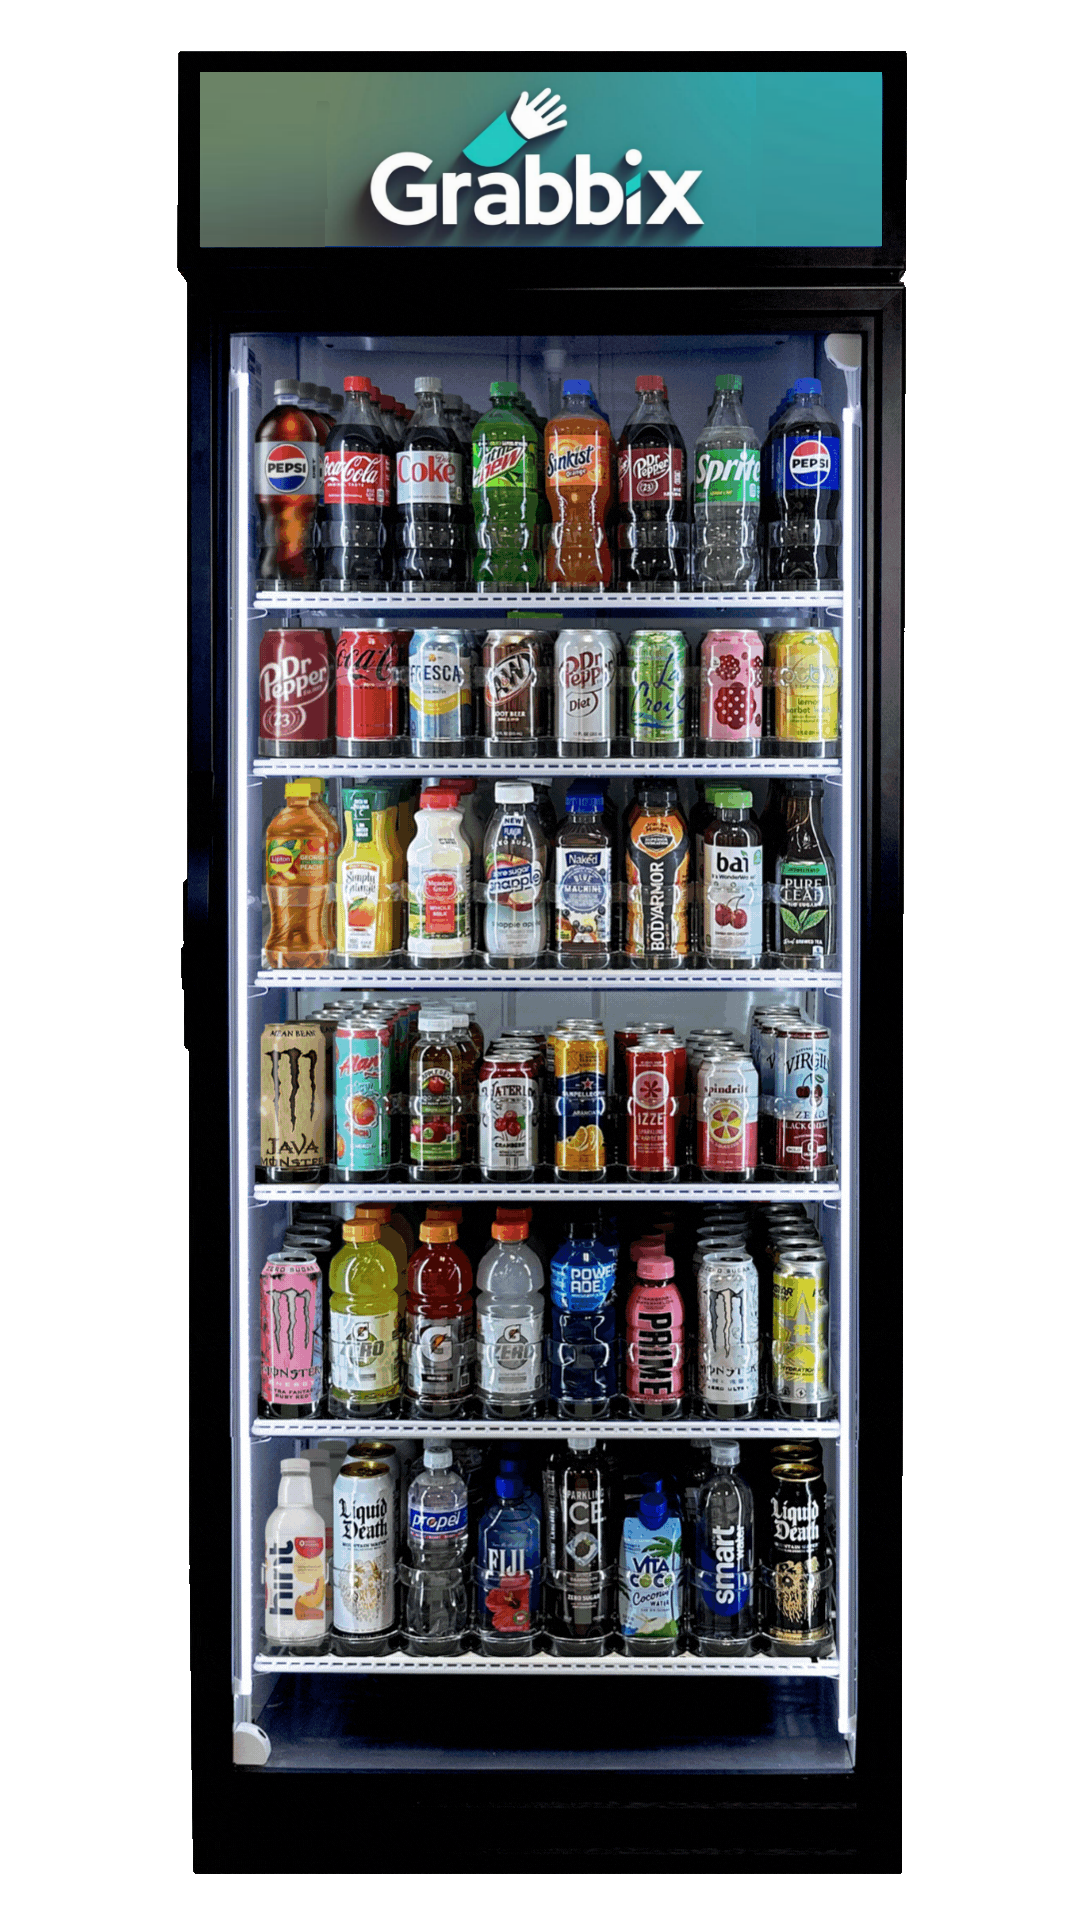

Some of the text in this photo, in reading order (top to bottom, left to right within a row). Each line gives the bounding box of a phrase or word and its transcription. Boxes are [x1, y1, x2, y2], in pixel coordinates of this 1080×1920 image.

[370, 148, 704, 227] Grabbix
[646, 454, 661, 464] Dr
[791, 458, 829, 469] PEPSI
[266, 462, 306, 473] PEPSI
[397, 455, 456, 484] Coke
[633, 457, 669, 480] Pepper
[696, 450, 760, 489] Sprite
[641, 483, 652, 491] 23
[281, 655, 313, 680] Dr
[579, 651, 602, 672] Dr
[261, 662, 328, 703] Pepper
[494, 654, 526, 701] A&W
[569, 697, 591, 713] Diet
[273, 712, 290, 728] 23
[510, 710, 526, 718] BEER
[504, 817, 522, 825] NEW
[717, 850, 749, 873] bai
[346, 870, 376, 885] Simply
[508, 865, 531, 877] sugar
[572, 873, 596, 883] BLUE
[563, 884, 602, 894] MACHINE
[784, 878, 823, 890] PURE
[784, 889, 820, 902] LEAF
[649, 861, 665, 952] BODYARMOR
[295, 1029, 317, 1038] BEAN
[339, 1052, 384, 1078] Alan
[704, 1083, 749, 1097] spindrift
[637, 1112, 664, 1126] IZZE
[795, 1110, 826, 1119] ZERO
[265, 1132, 319, 1155] JAVA
[261, 1156, 325, 1167] MONSTER
[289, 1265, 315, 1273] SUGAR
[571, 1280, 601, 1293] ADE
[494, 1344, 535, 1360] ZERO
[638, 1312, 673, 1395] PRIME
[262, 1365, 322, 1380] MONSTER
[701, 1364, 756, 1378] MONSTR
[338, 1497, 388, 1526] Liquid
[566, 1499, 605, 1526] CE
[770, 1497, 819, 1527] Liquid
[342, 1517, 388, 1540] Death
[412, 1510, 461, 1531] propel
[774, 1518, 820, 1542] Death
[735, 1524, 746, 1560] water
[488, 1547, 525, 1577] FIJI
[631, 1555, 670, 1574] VITA
[711, 1525, 735, 1604] smart
[269, 1539, 293, 1615] hint
[630, 1573, 675, 1589] COCO
[567, 1592, 601, 1601] ZERO SUGAR
[632, 1590, 670, 1607] Coconut
[650, 1599, 670, 1607] WATER
